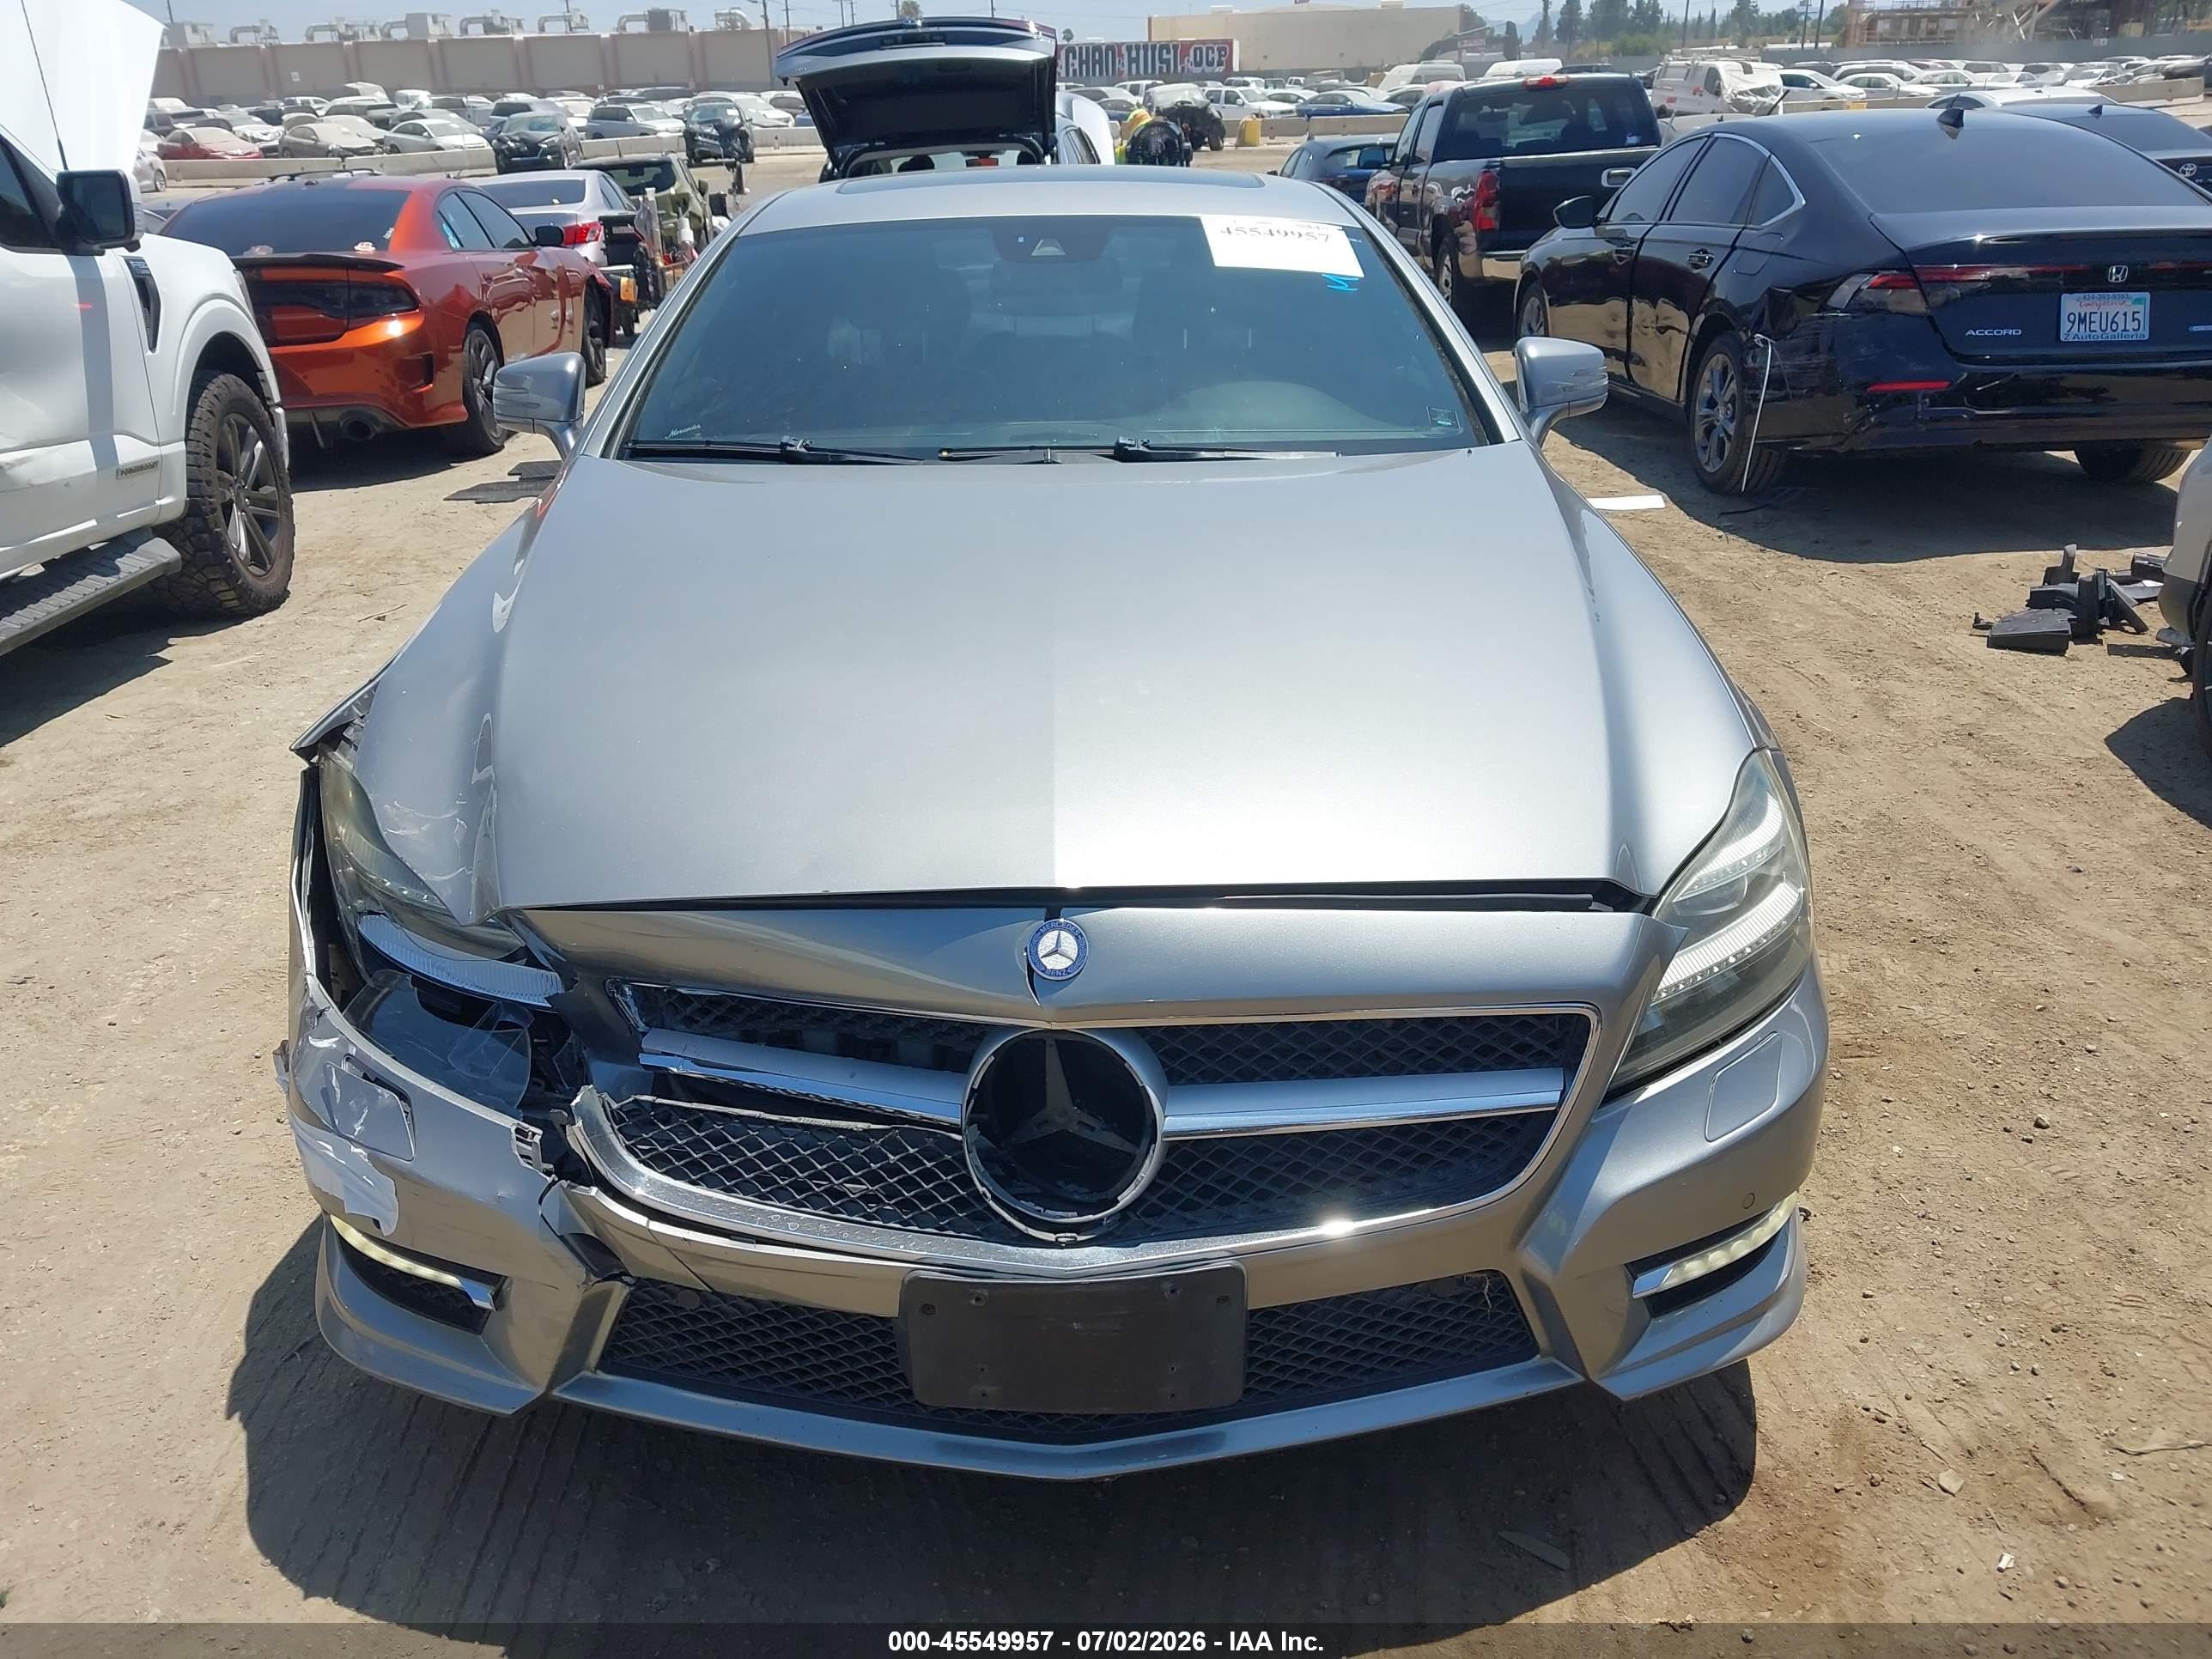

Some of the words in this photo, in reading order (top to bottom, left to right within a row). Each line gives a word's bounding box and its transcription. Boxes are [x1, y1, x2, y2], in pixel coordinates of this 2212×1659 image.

[1221, 226, 1329, 243] 45549957
[2067, 311, 2142, 333] 9MEU615
[1040, 921, 1081, 936] MERCEDES
